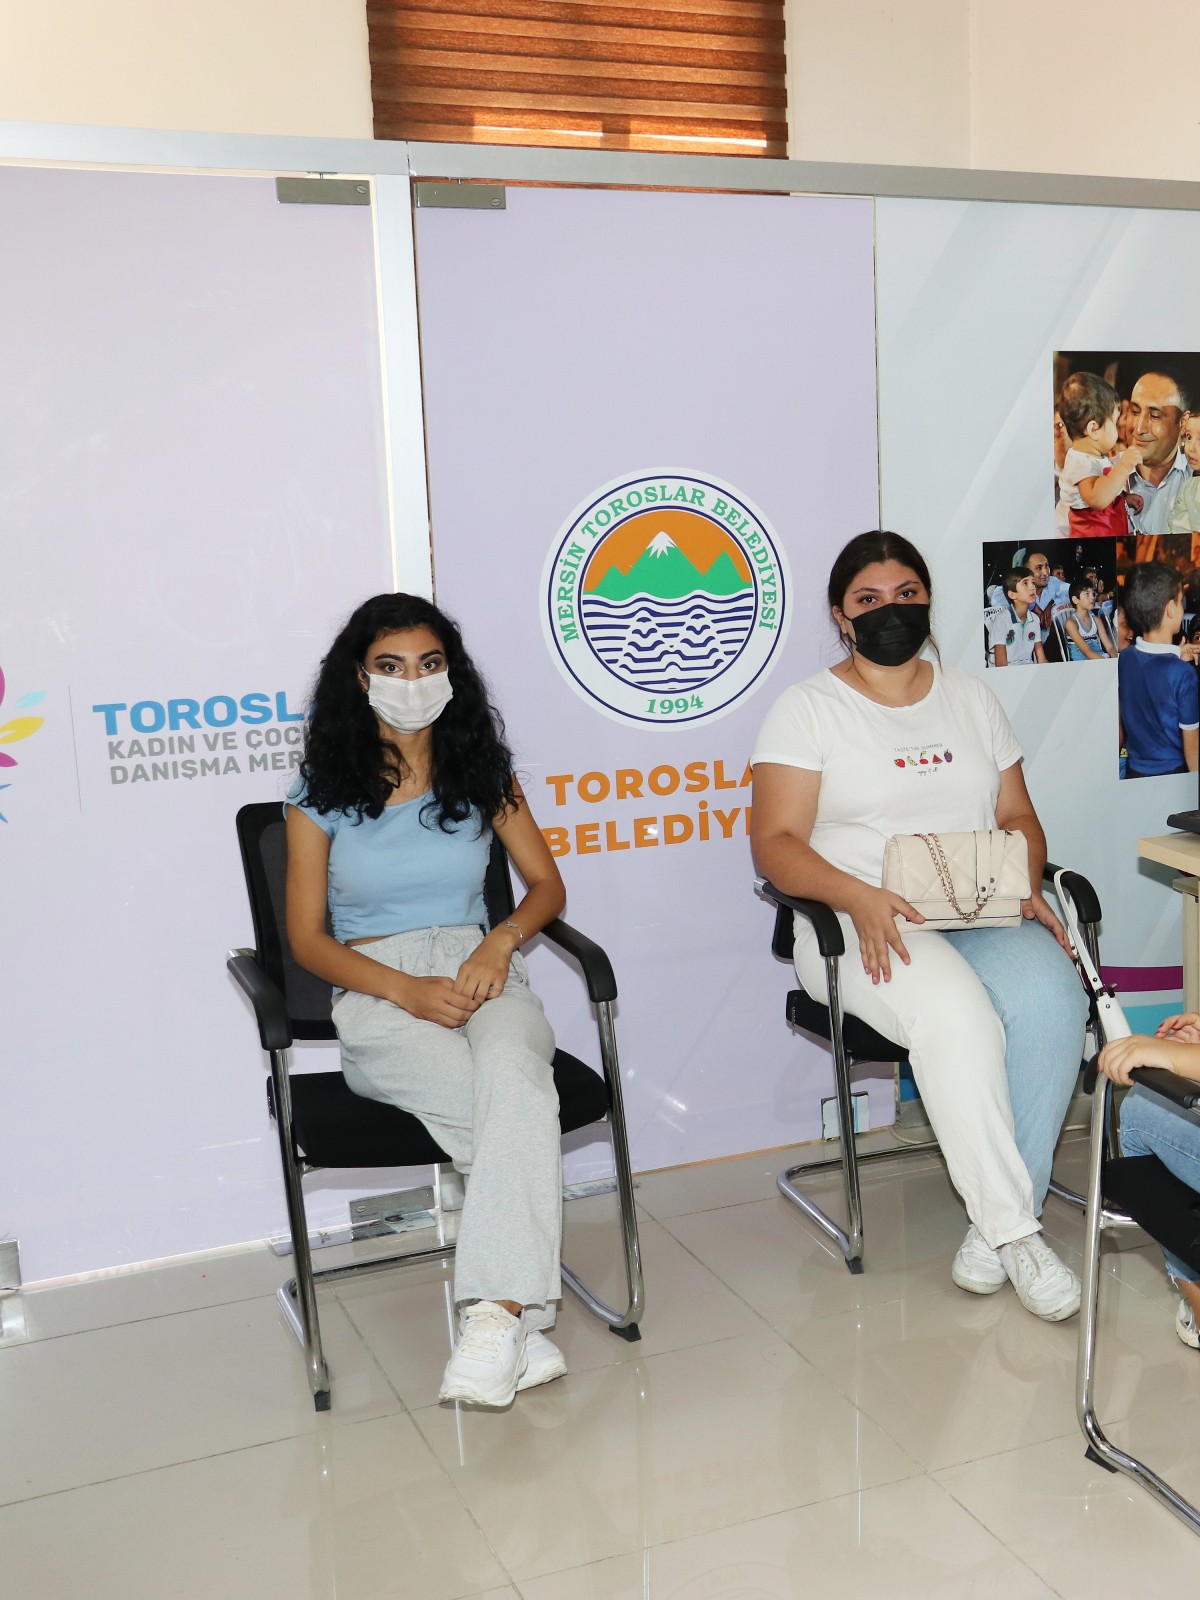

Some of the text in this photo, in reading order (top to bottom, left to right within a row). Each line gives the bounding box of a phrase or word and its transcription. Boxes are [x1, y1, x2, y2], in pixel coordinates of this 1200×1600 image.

[557, 485, 778, 644] MERSİN TOROSLAR BELEDİYESİ
[92, 691, 318, 735] TOROSL
[644, 693, 704, 715] 1994
[108, 725, 310, 760] KADIN VE ÇOC
[110, 755, 242, 785] DANIŞMA
[540, 799, 752, 858] BELEDİY
